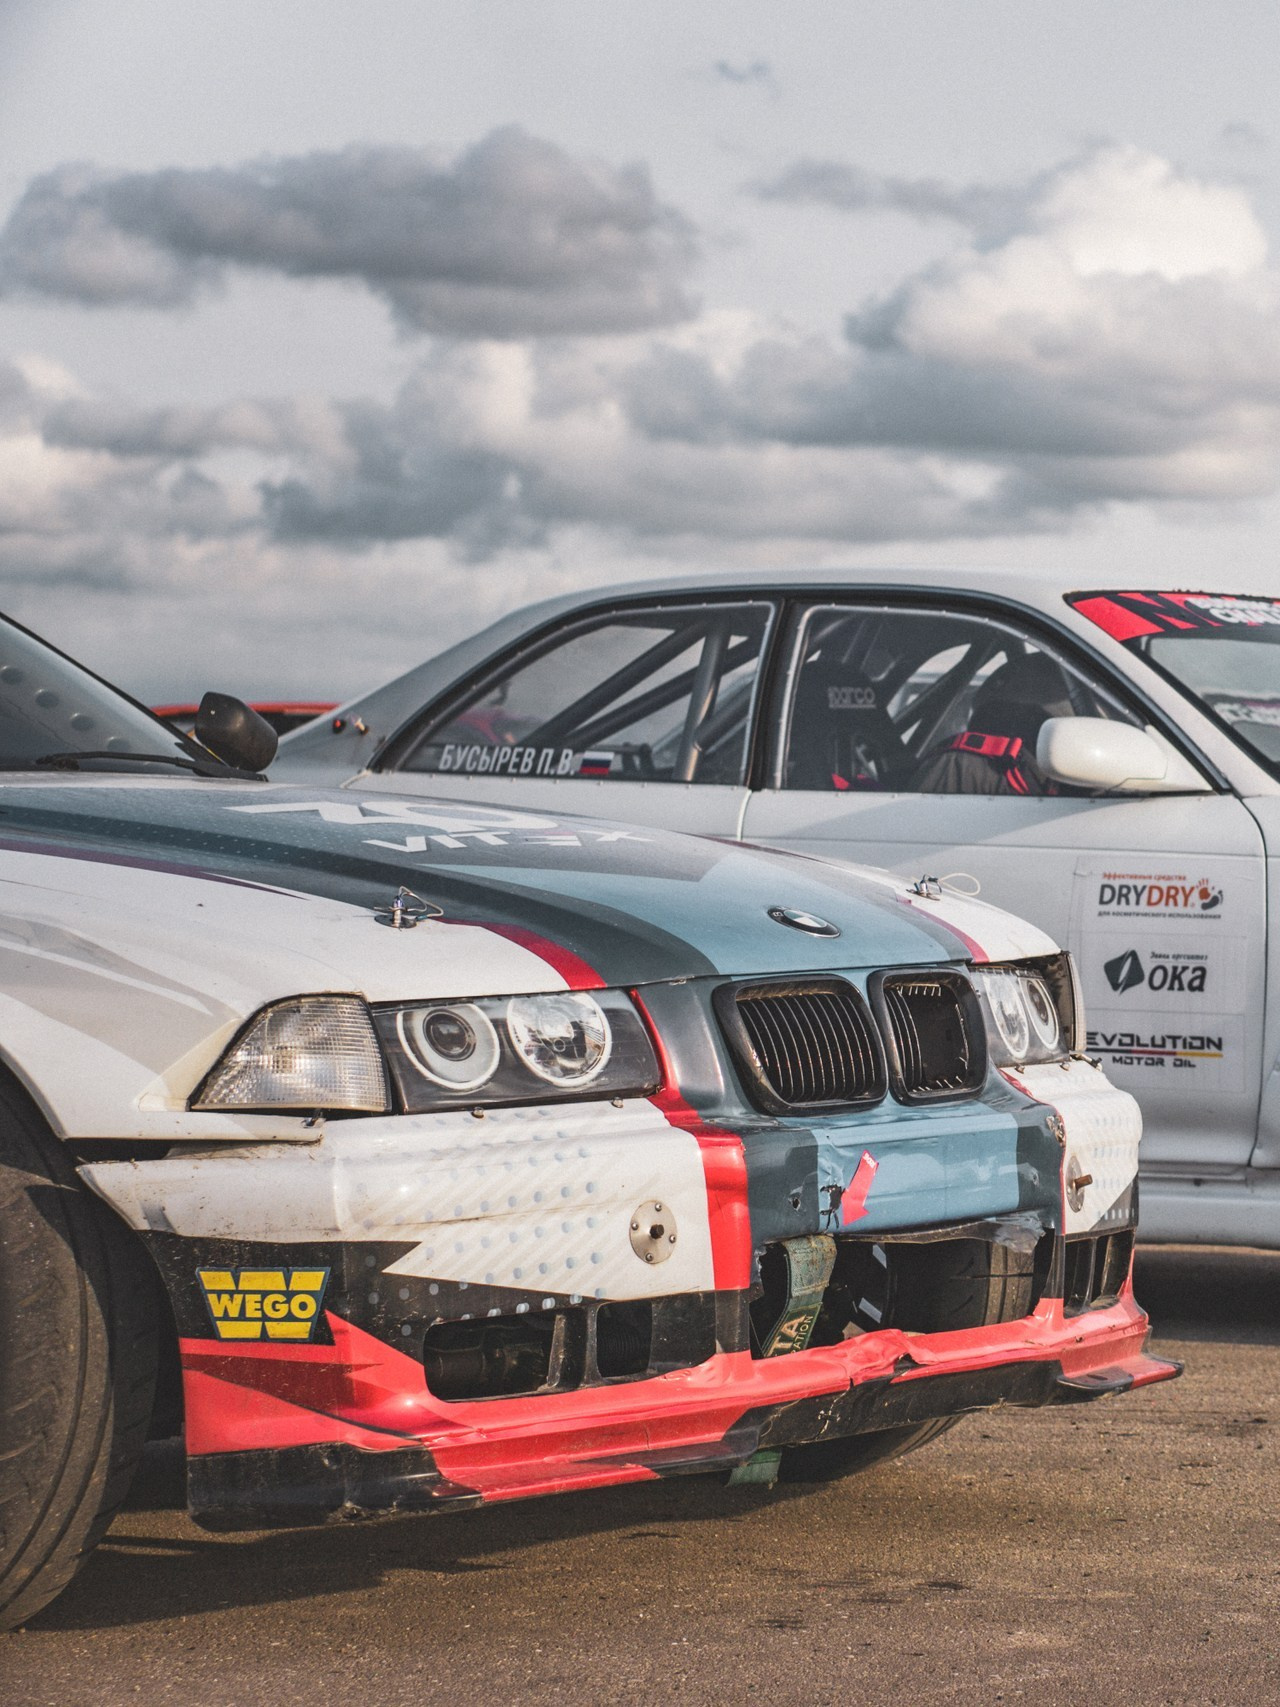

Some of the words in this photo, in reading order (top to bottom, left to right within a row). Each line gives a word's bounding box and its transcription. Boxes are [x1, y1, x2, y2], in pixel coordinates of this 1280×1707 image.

[438, 744, 535, 775] БУСЫРЕВ
[1112, 1056, 1165, 1067] MOTOR
[1173, 1058, 1196, 1068] OIL
[207, 1293, 317, 1319] WEGO
[764, 1315, 806, 1357] TA
